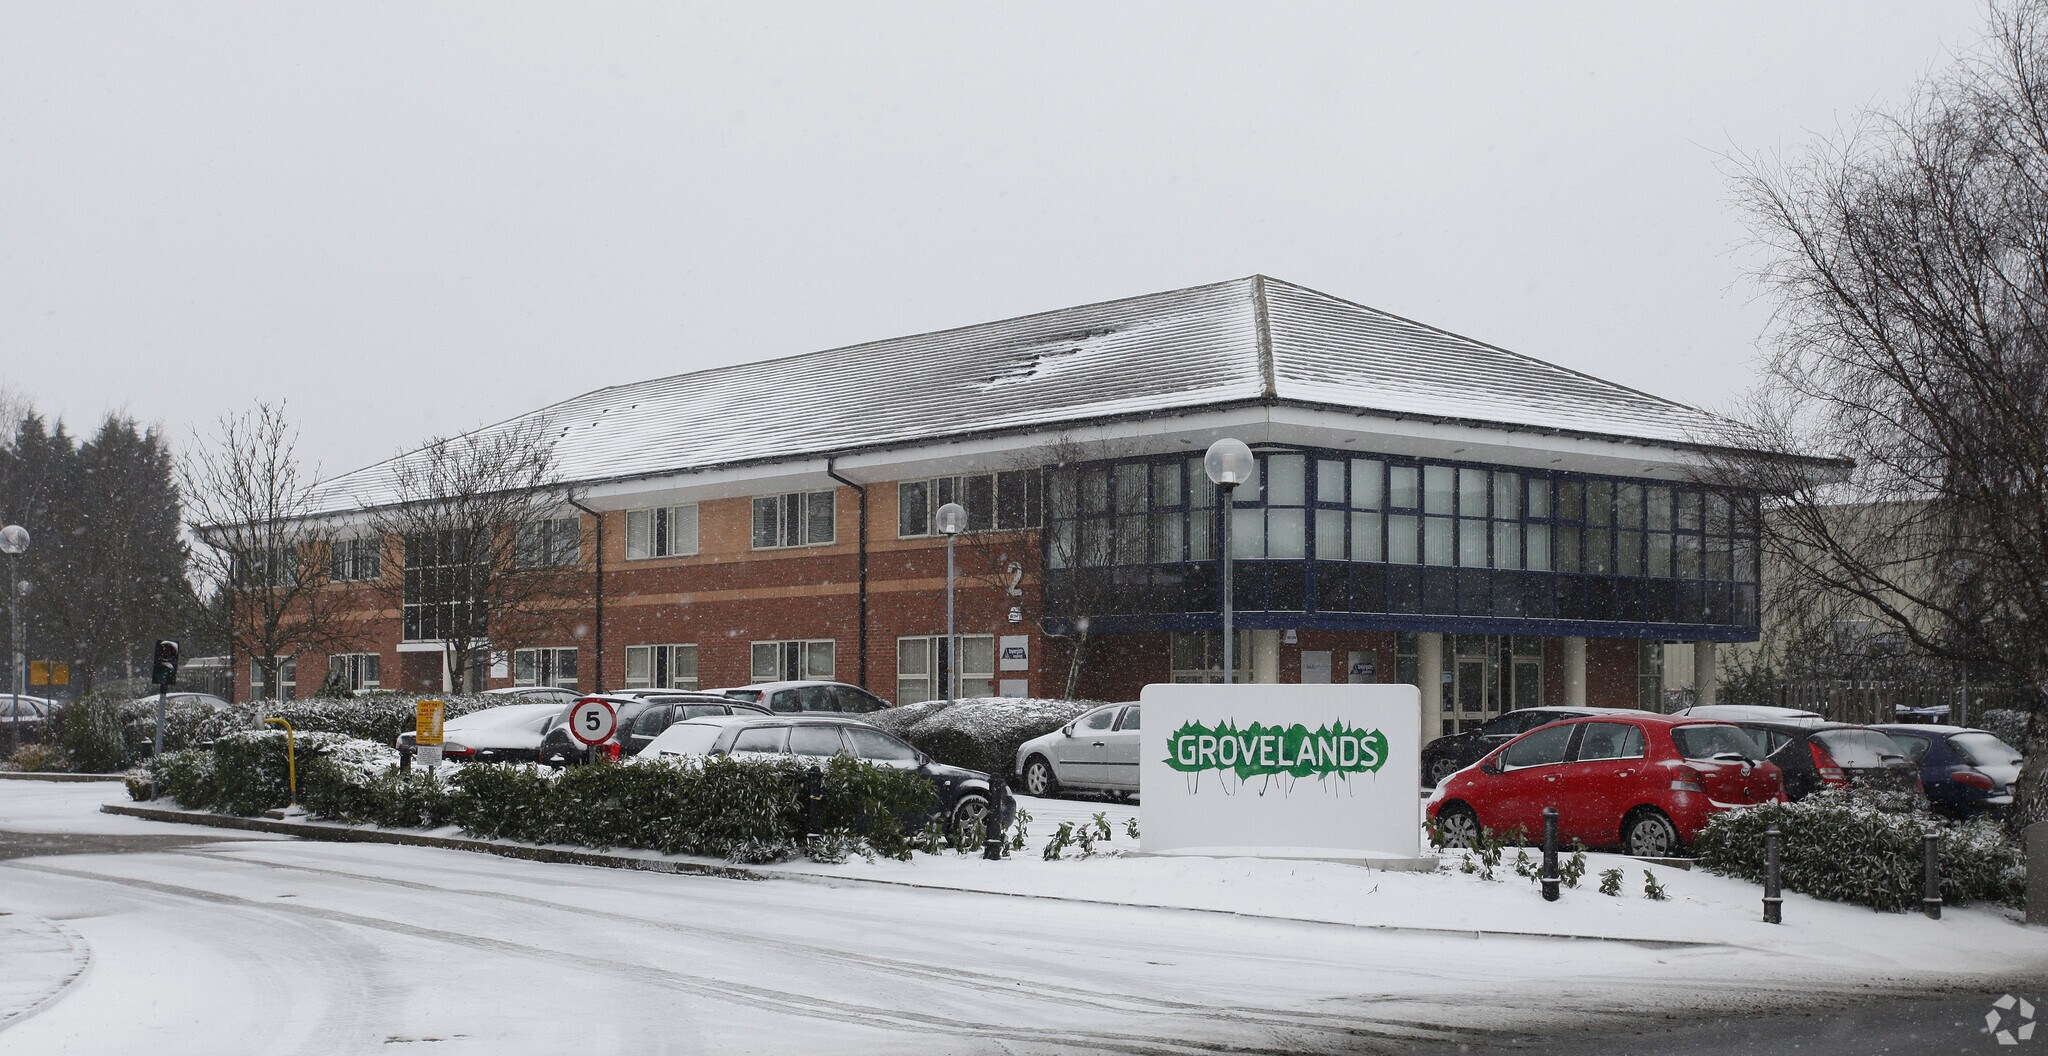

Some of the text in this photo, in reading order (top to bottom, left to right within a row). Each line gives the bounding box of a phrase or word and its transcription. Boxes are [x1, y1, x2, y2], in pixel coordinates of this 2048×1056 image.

[1007, 561, 1023, 597] 2
[586, 711, 601, 731] 5
[1177, 735, 1378, 766] GROVELANDS
